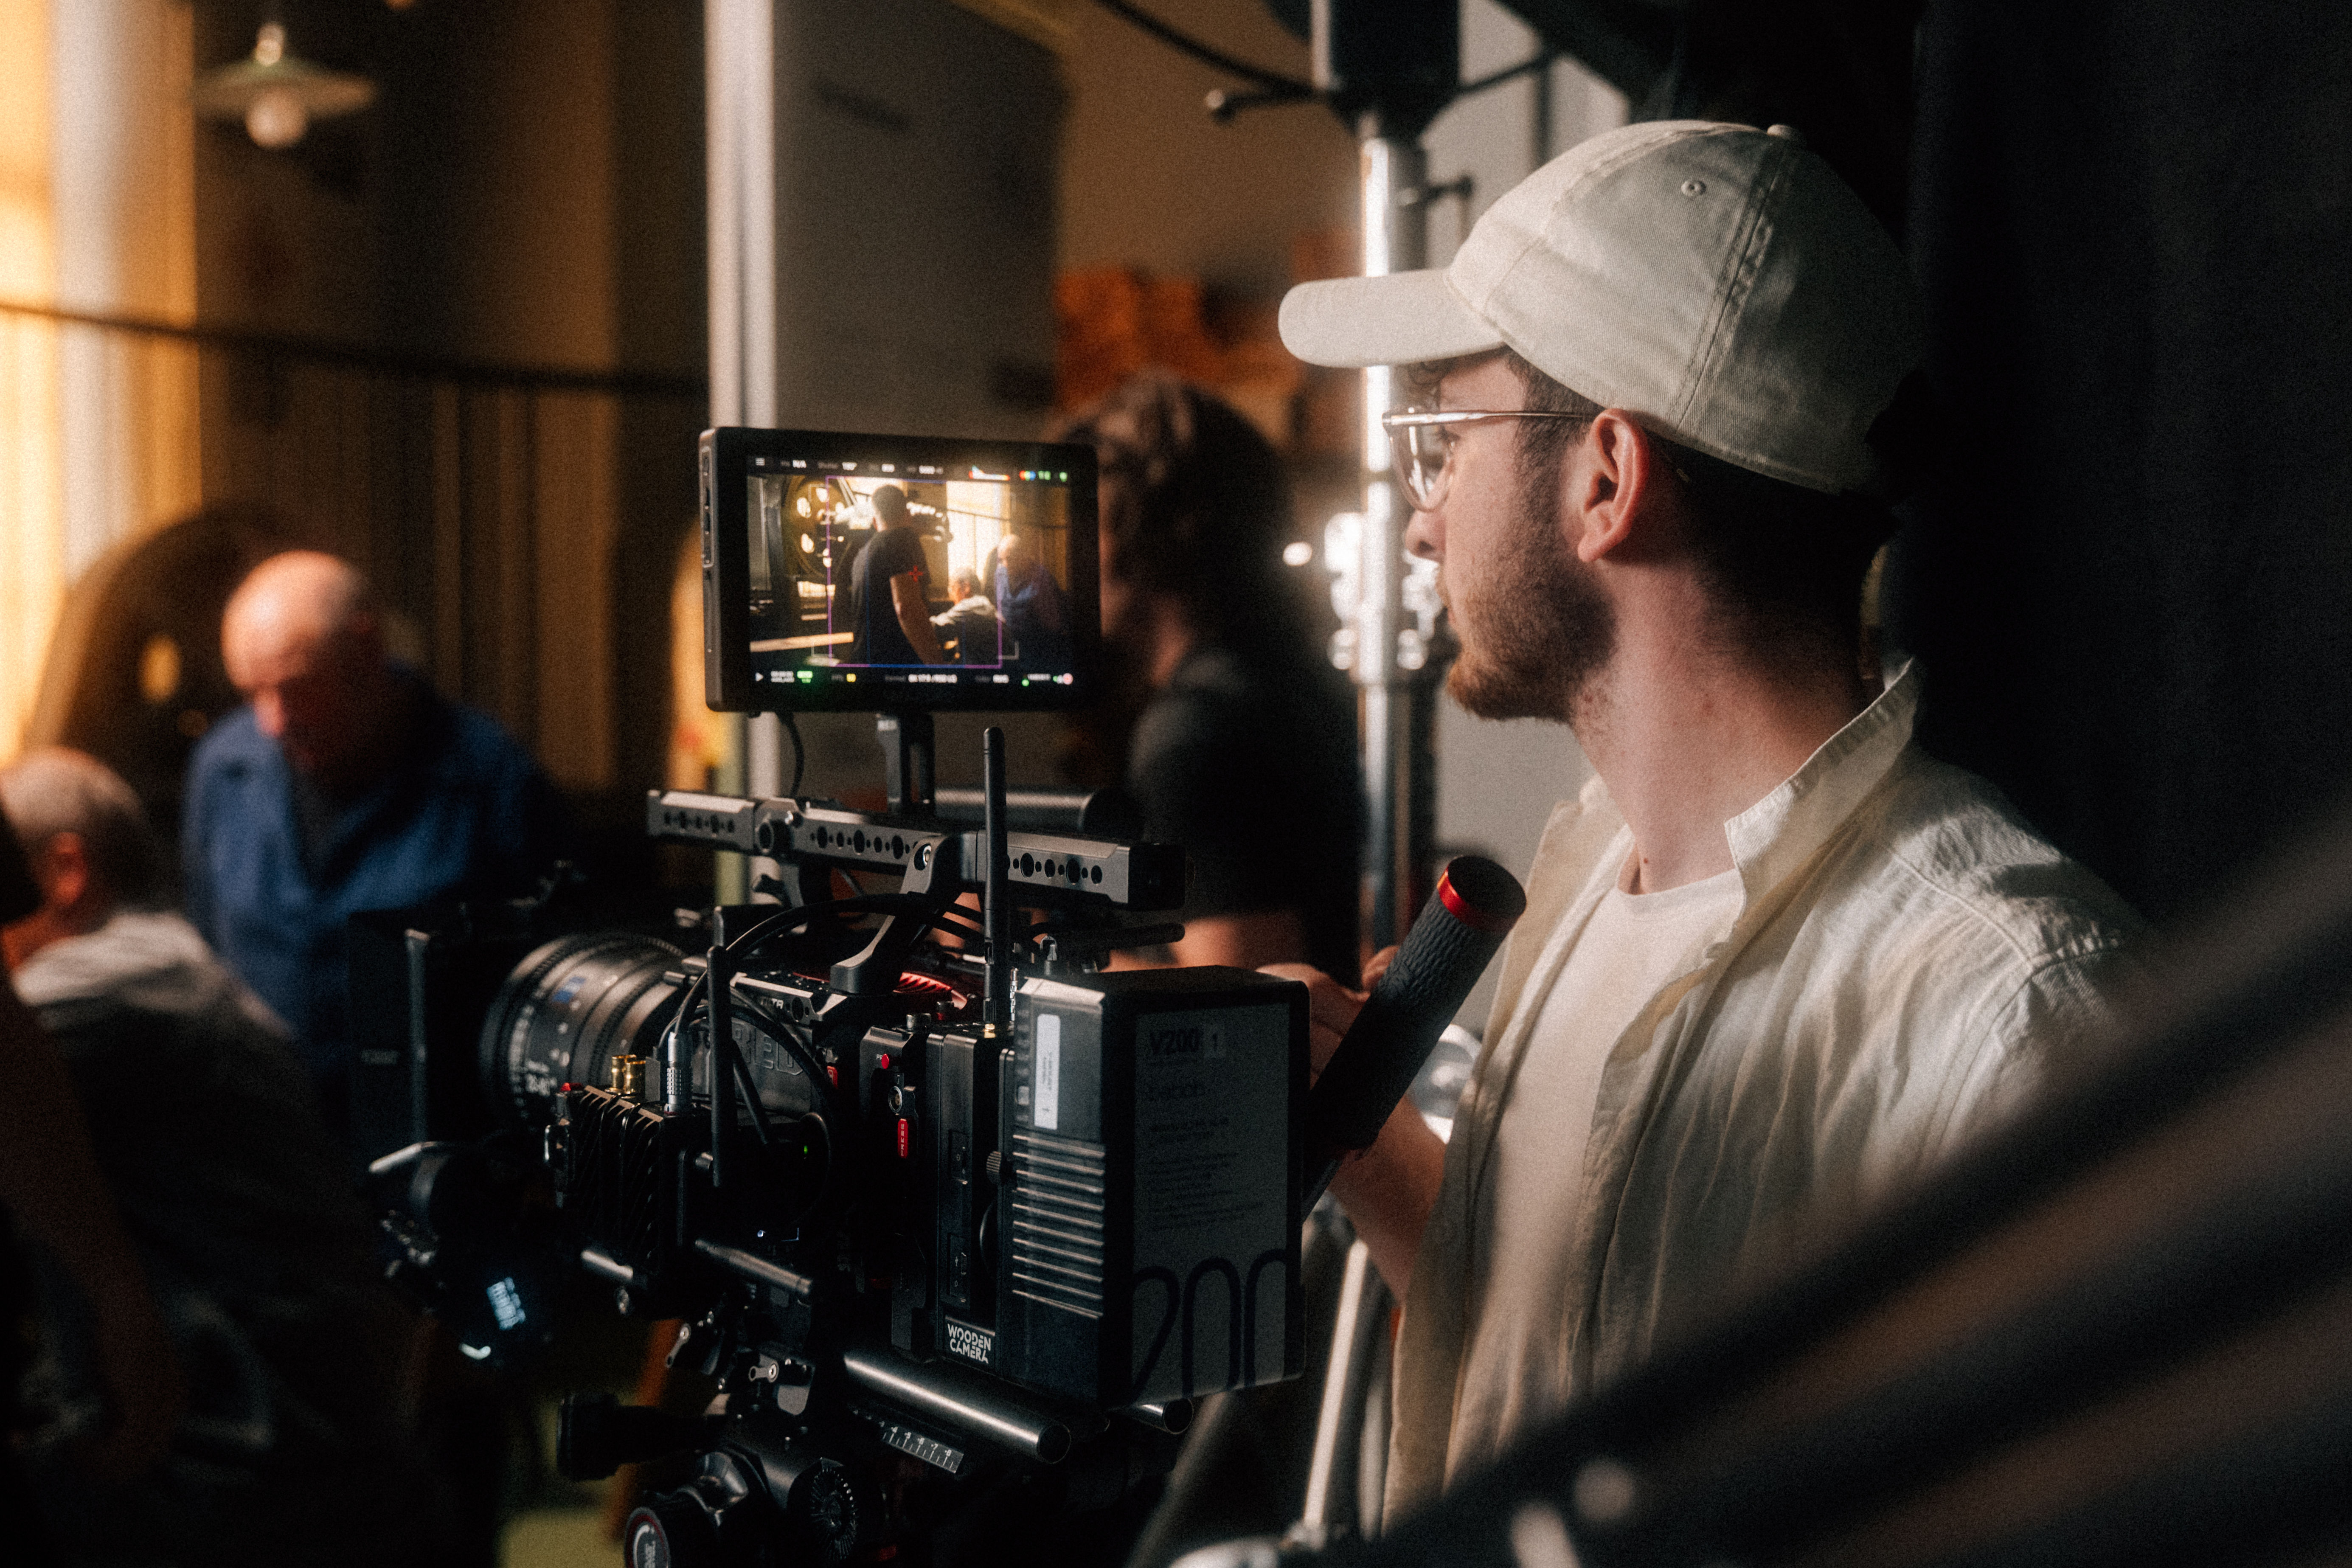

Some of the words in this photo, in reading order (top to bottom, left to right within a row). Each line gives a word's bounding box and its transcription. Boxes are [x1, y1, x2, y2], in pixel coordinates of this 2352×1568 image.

[1149, 1028, 1200, 1055] V200
[947, 1324, 991, 1352] WOODEN
[950, 1338, 989, 1364] CAMERA
